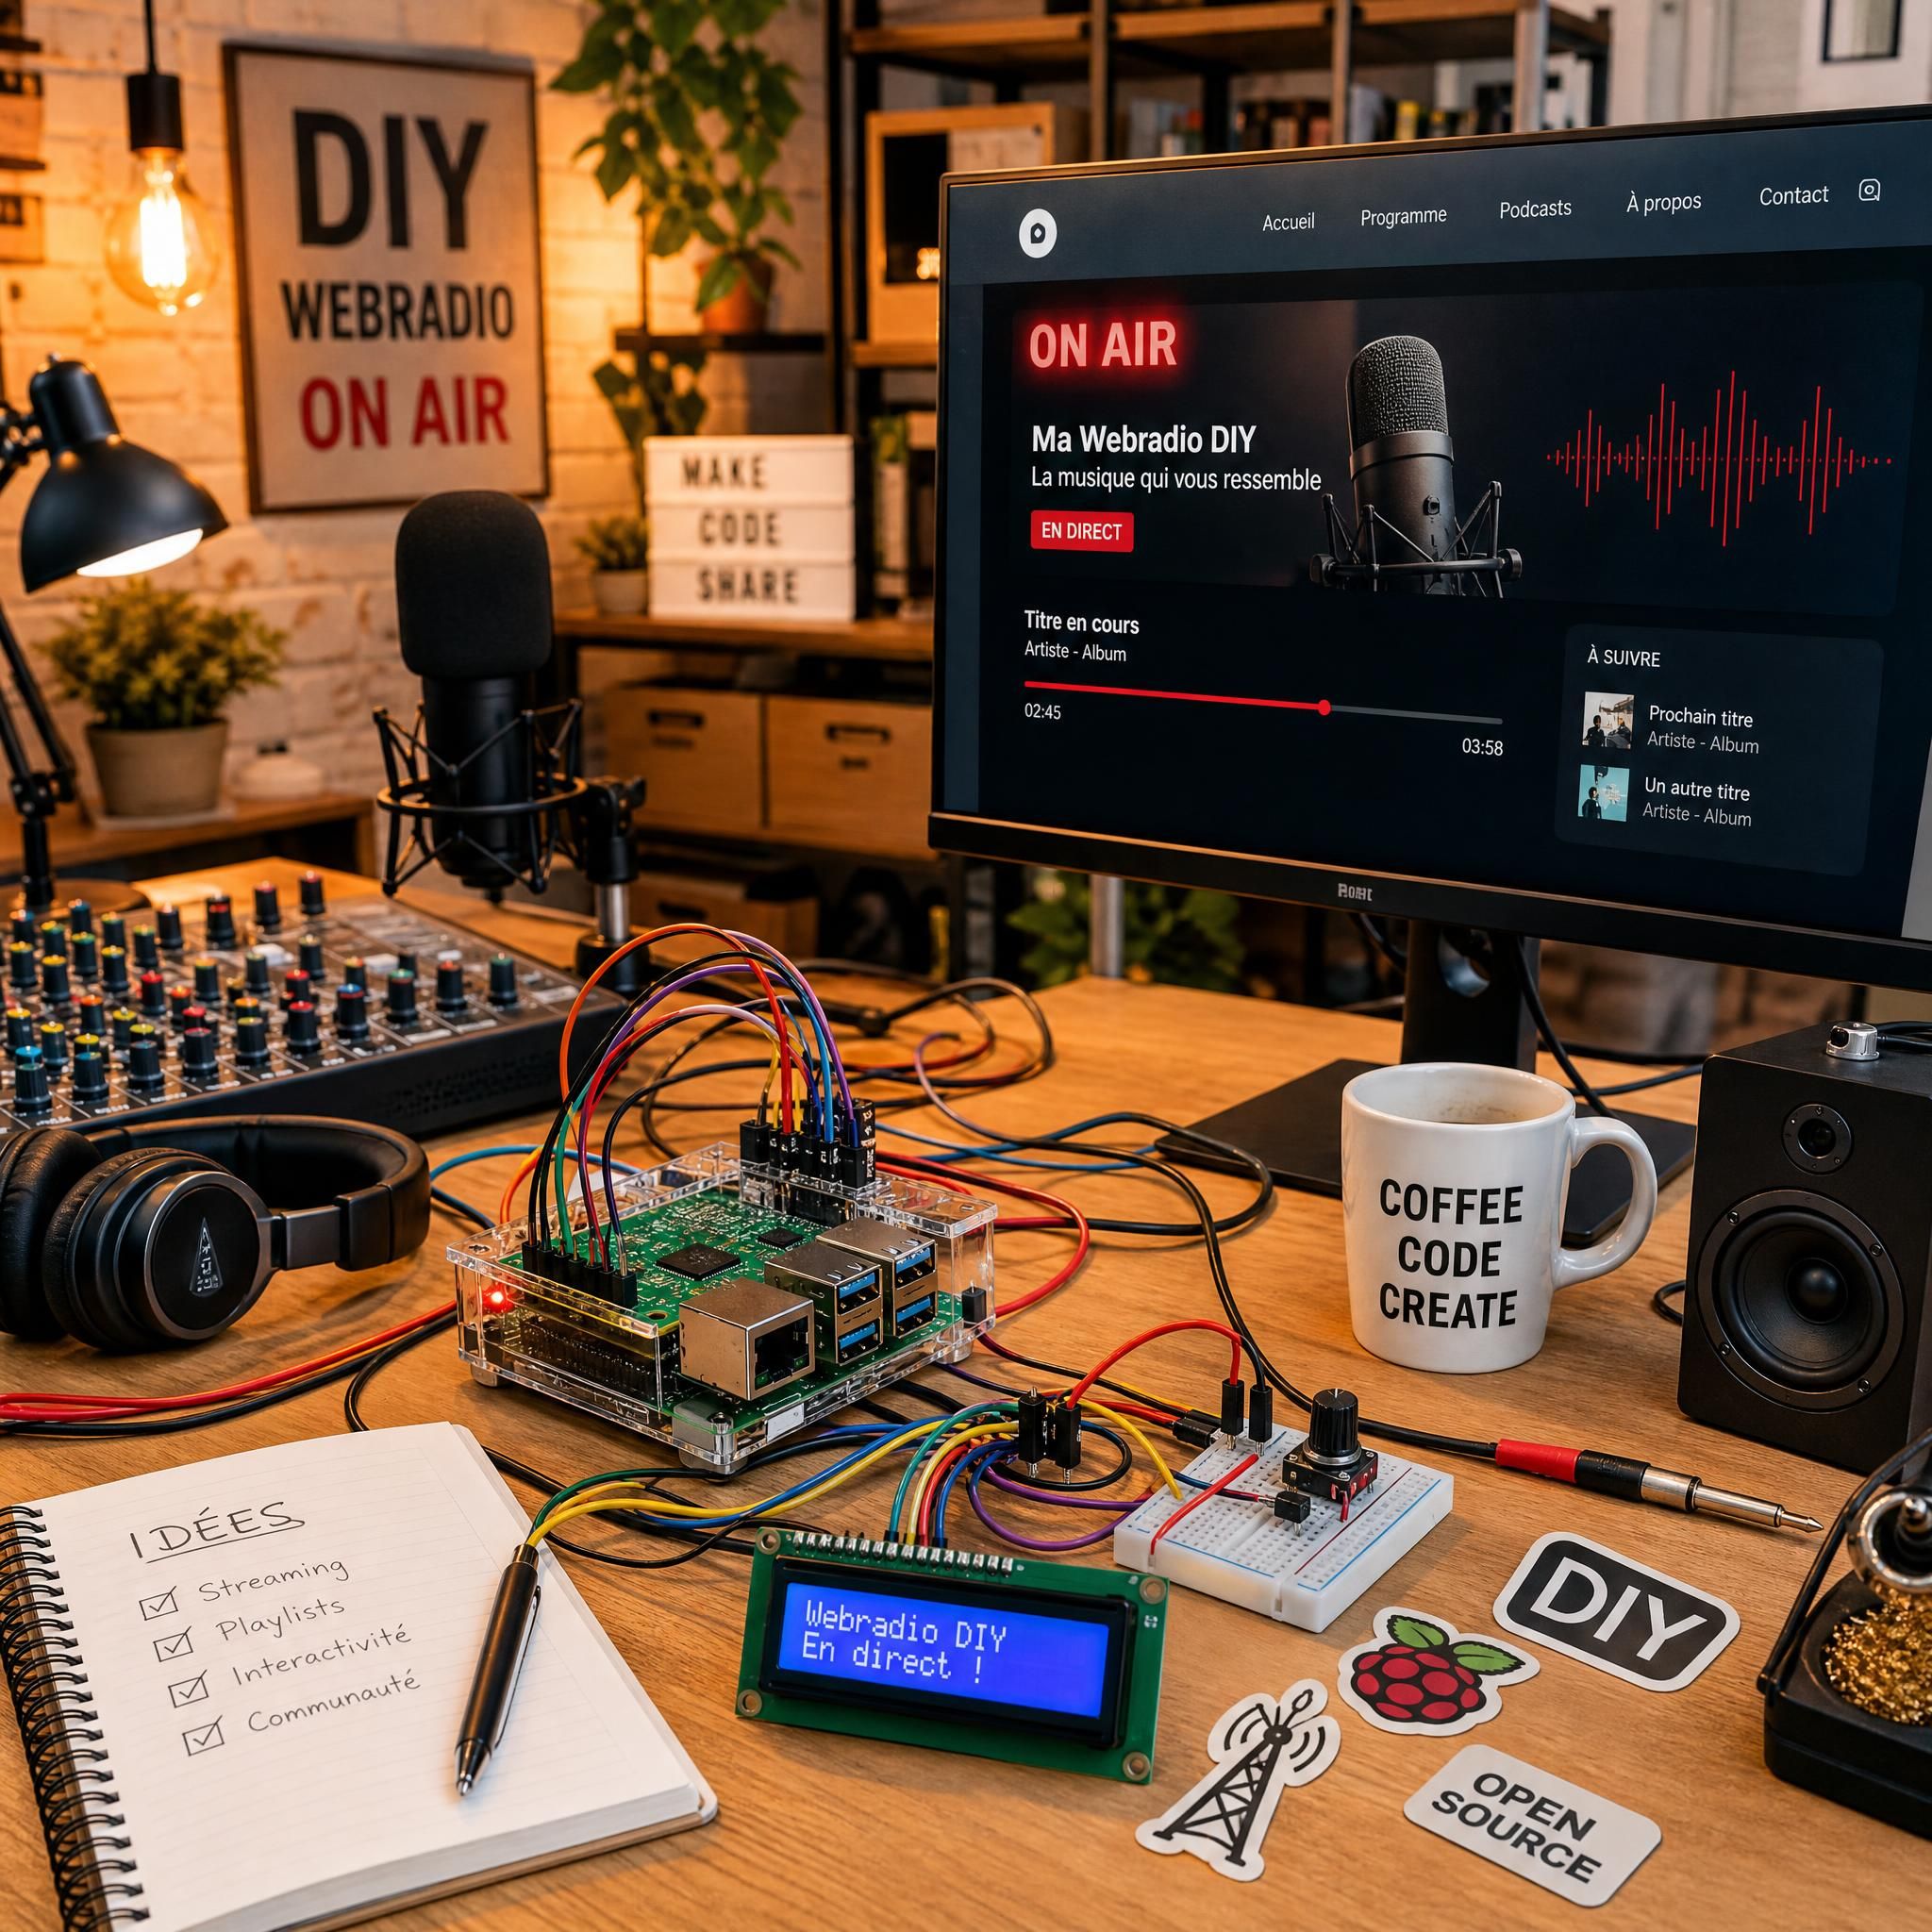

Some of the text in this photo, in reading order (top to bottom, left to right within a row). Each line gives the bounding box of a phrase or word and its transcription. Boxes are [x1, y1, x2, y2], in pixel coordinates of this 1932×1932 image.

[291, 107, 490, 251] DIY
[1262, 185, 1830, 232] Accueil Programme Podcasts À propos Contact
[280, 281, 513, 341] WEBRADIO
[1029, 320, 1177, 369] ON AIR
[300, 375, 508, 452] ON AIR
[1032, 424, 1257, 454] Ma Webradio DIY
[682, 456, 763, 490] MAKE
[1031, 465, 1322, 494] La musique qui vous ressemble
[700, 511, 778, 547] CODE
[1041, 521, 1123, 541] EN DIRECT
[699, 568, 795, 604] SHARE
[1024, 609, 1140, 635] Titre en cours
[1024, 640, 1070, 658] Artiste
[1081, 643, 1126, 662] Album
[1587, 643, 1661, 668] À SUIVRE
[1024, 702, 1061, 721] 02:45
[1649, 705, 1754, 728] Prochain titre
[1462, 738, 1504, 757] 03:58
[1646, 730, 1696, 749] Artiste
[1709, 735, 1759, 755] Album
[1645, 776, 1751, 802] Un autre titre
[1642, 802, 1690, 822] Artiste
[1703, 808, 1752, 827] Album
[1379, 1178, 1524, 1225] COFFEE
[1397, 1235, 1502, 1278] CODE
[1379, 1282, 1518, 1329] CREATE
[129, 1501, 292, 1558] IDÉES
[198, 1560, 349, 1602] Streaming
[215, 1598, 345, 1641] Playlists
[805, 1599, 1007, 1653] Webradio DIY
[1530, 1557, 1707, 1661] DIY
[232, 1623, 412, 1686] Interactivité
[802, 1630, 982, 1684] En direct !
[247, 1668, 422, 1732] Communauté
[1472, 1772, 1598, 1843] OPEN
[1431, 1790, 1603, 1886] SOURCE
